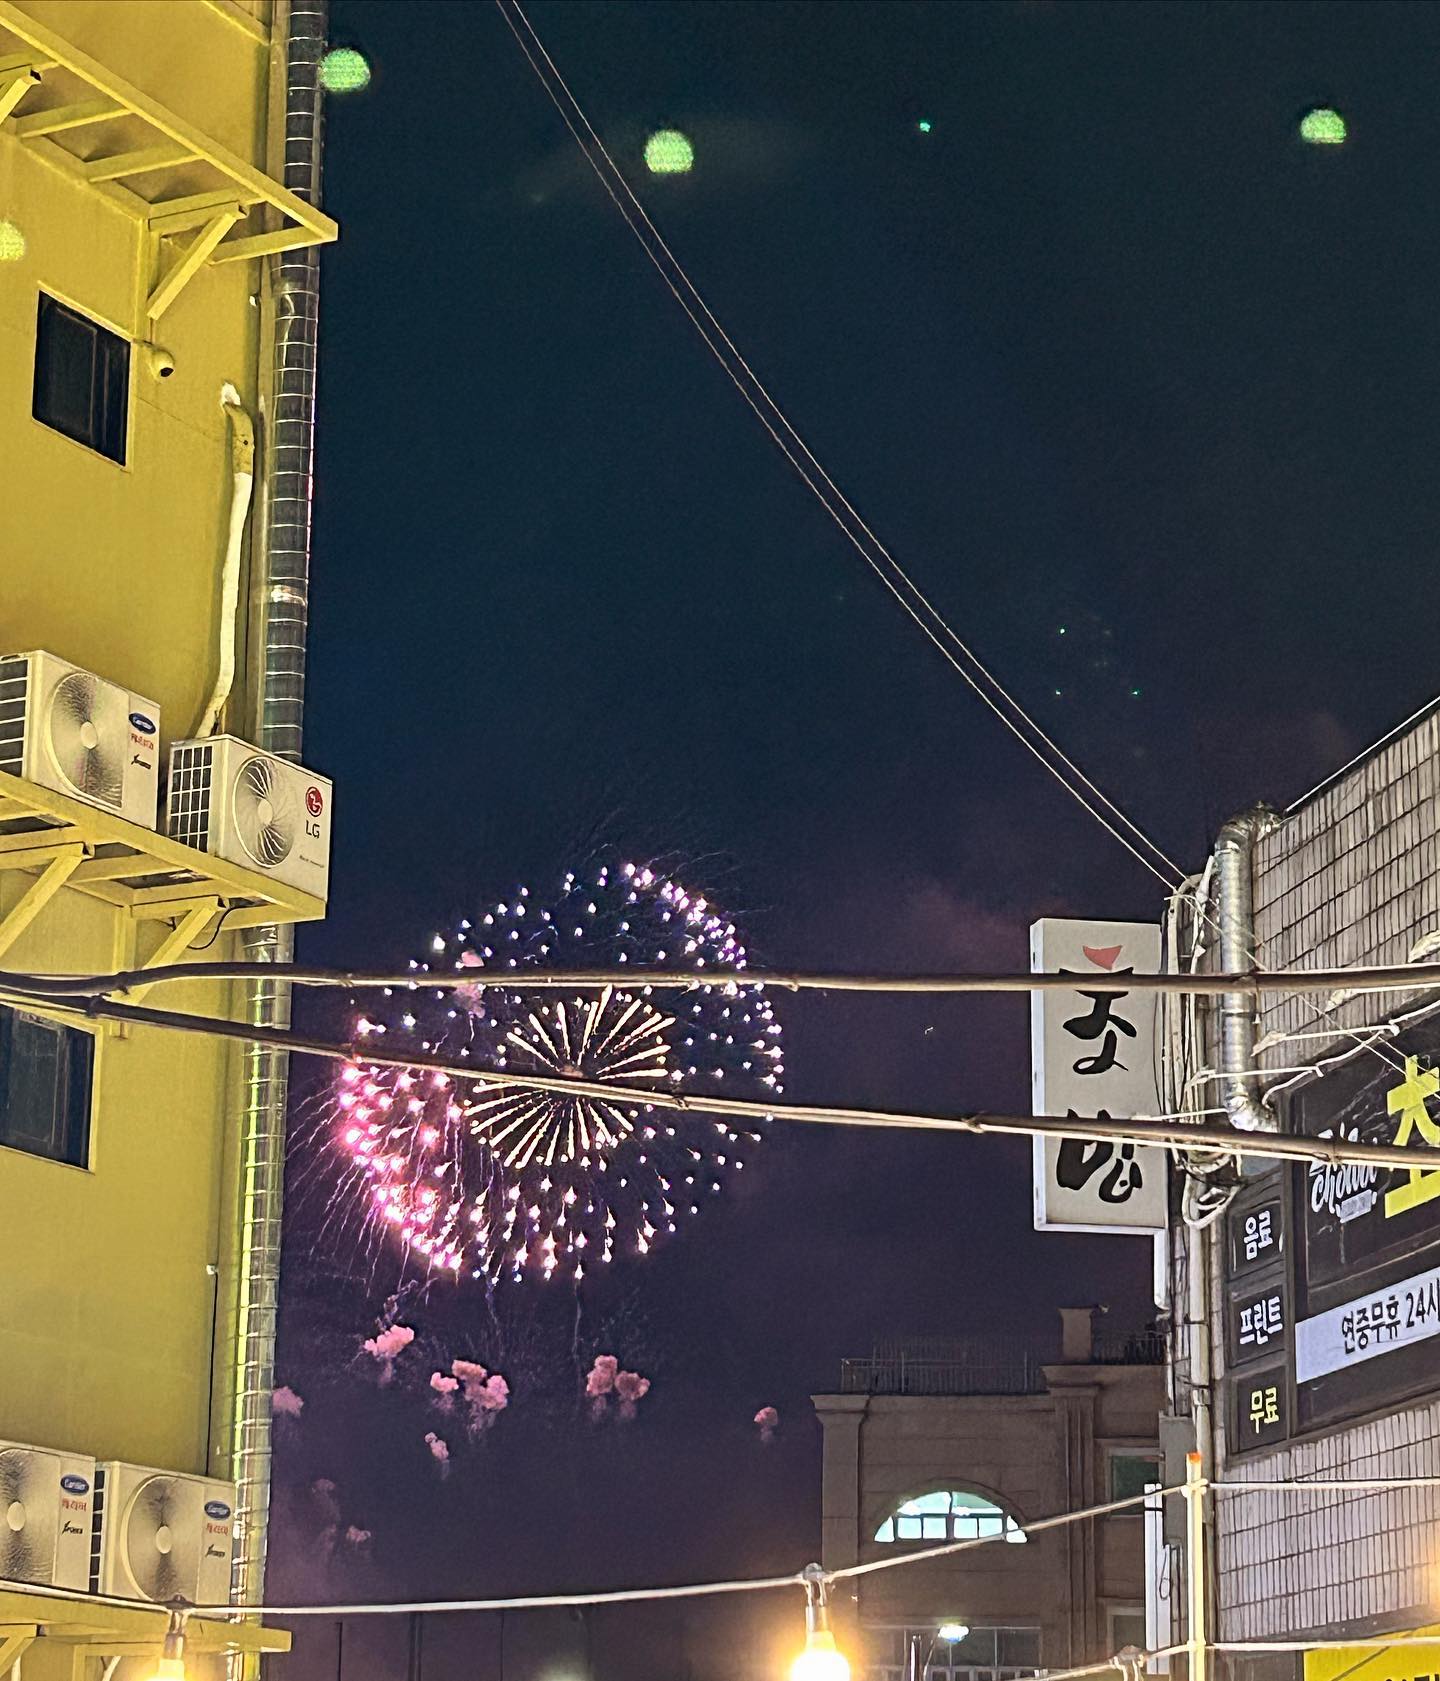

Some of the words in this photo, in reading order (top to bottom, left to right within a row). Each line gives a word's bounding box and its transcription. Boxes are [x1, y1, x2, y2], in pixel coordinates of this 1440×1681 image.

[305, 819, 320, 839] LG
[1243, 1210, 1273, 1261] 음료
[1239, 1295, 1283, 1345] 프린트
[1341, 1294, 1402, 1354] 연중무휴
[1249, 1386, 1280, 1434] 무료
